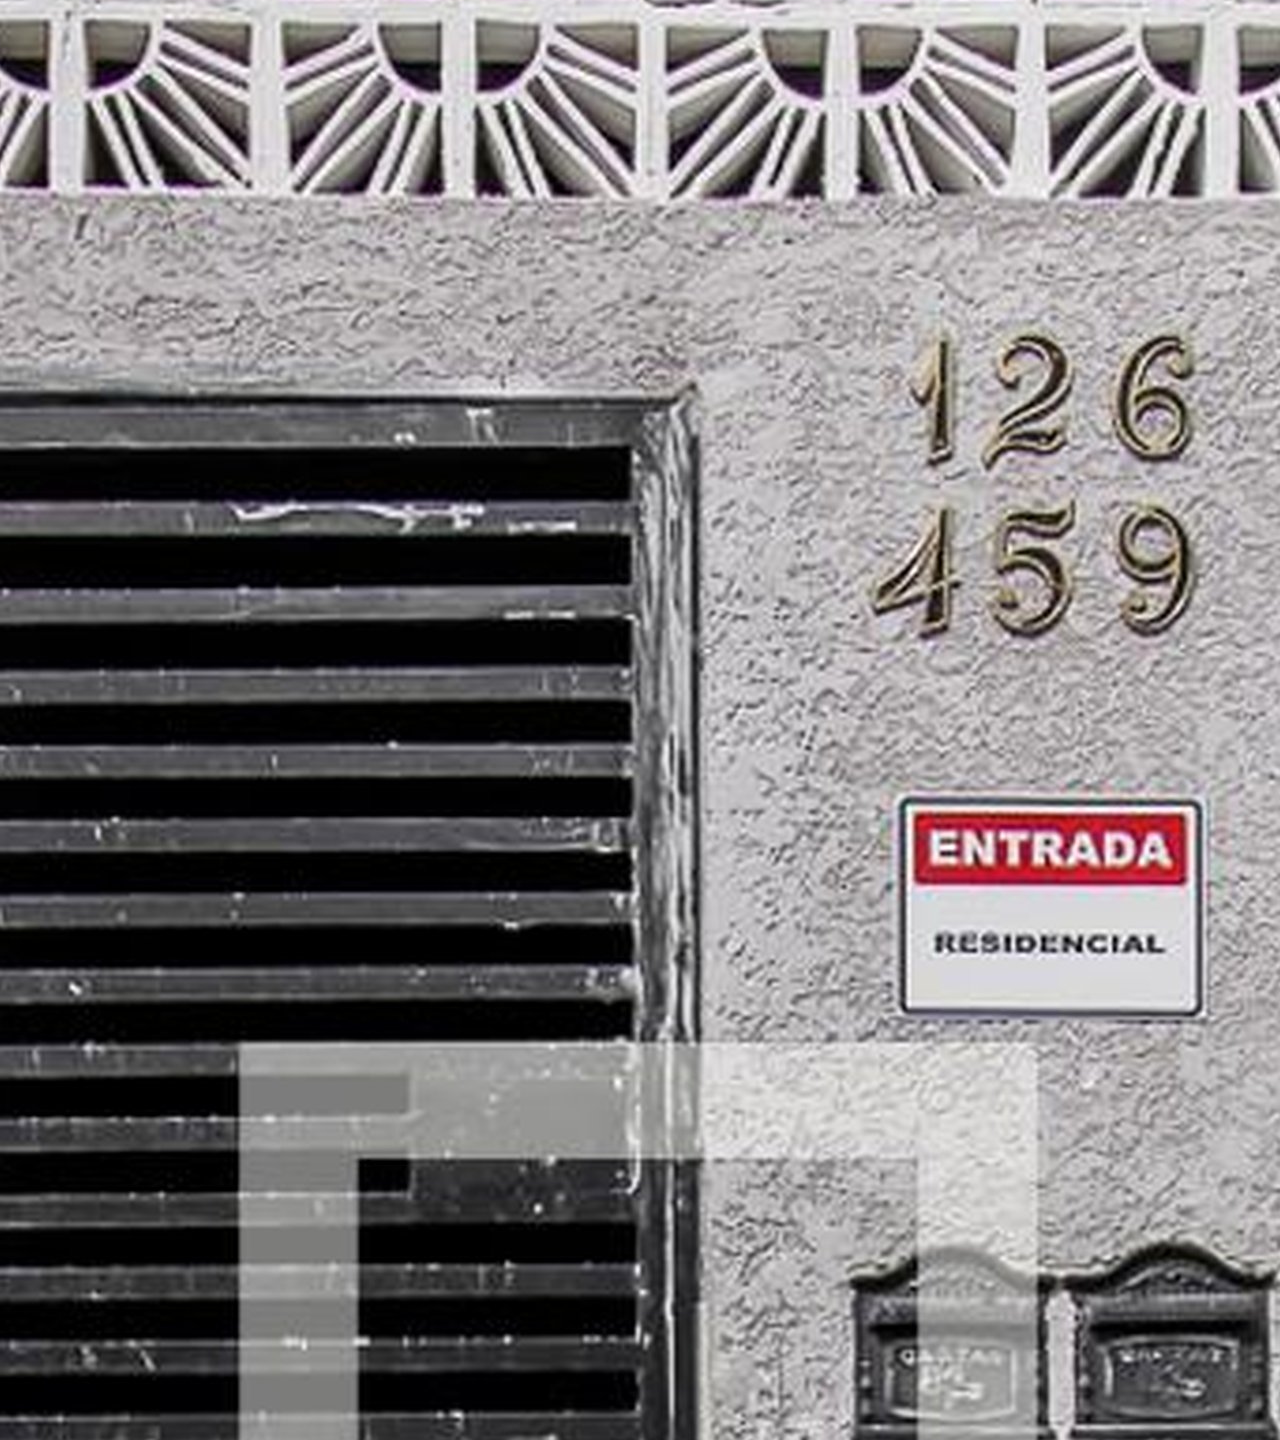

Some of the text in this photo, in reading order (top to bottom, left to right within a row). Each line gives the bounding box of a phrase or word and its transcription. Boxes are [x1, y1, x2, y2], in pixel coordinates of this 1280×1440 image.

[913, 334, 1194, 470] 126
[872, 502, 1194, 638] 459
[929, 828, 1173, 868] ENTRADA
[934, 933, 1166, 954] RESIDENCIAL
